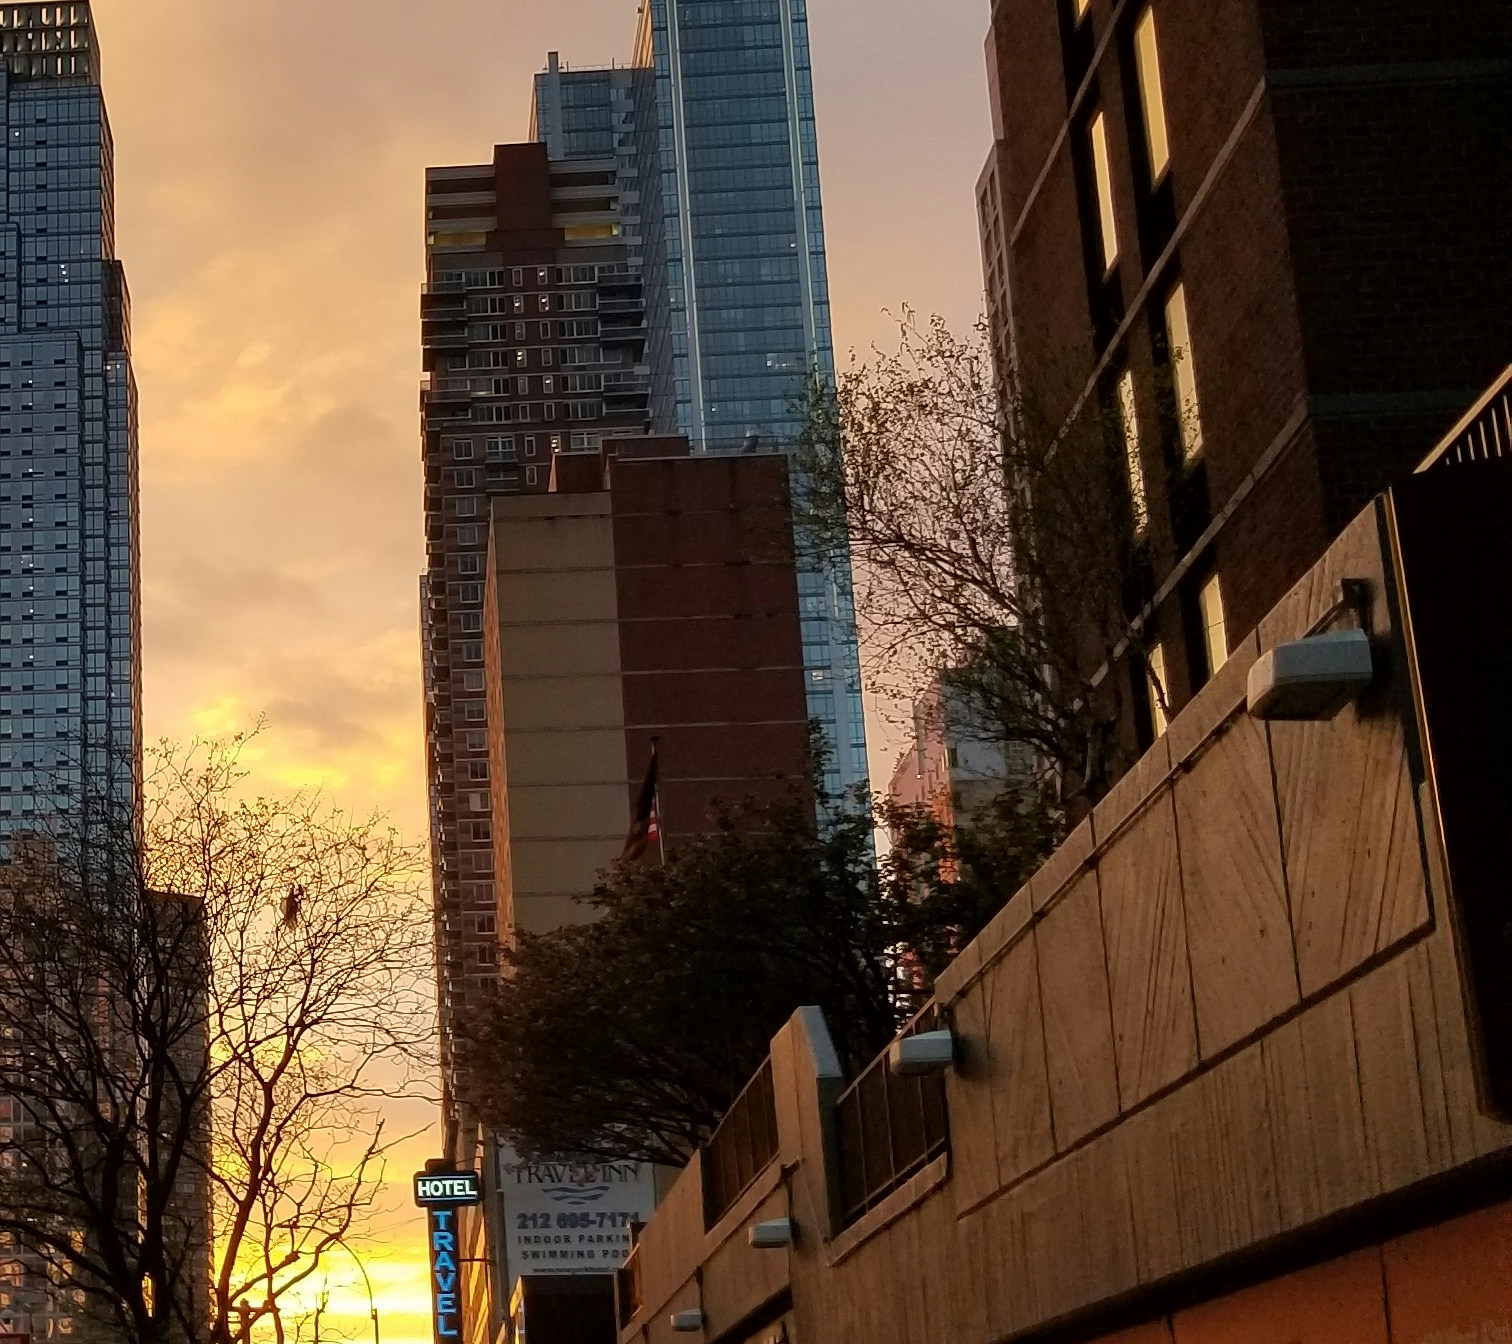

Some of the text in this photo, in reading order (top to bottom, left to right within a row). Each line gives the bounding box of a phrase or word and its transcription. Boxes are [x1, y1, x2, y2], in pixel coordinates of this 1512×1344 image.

[417, 1179, 478, 1198] HOTEL
[517, 1212, 551, 1229] 212
[517, 1234, 630, 1244] INDOOR PARKIN
[521, 1249, 629, 1259] SWIMMING POO
[432, 1211, 458, 1337] TRAVEL
